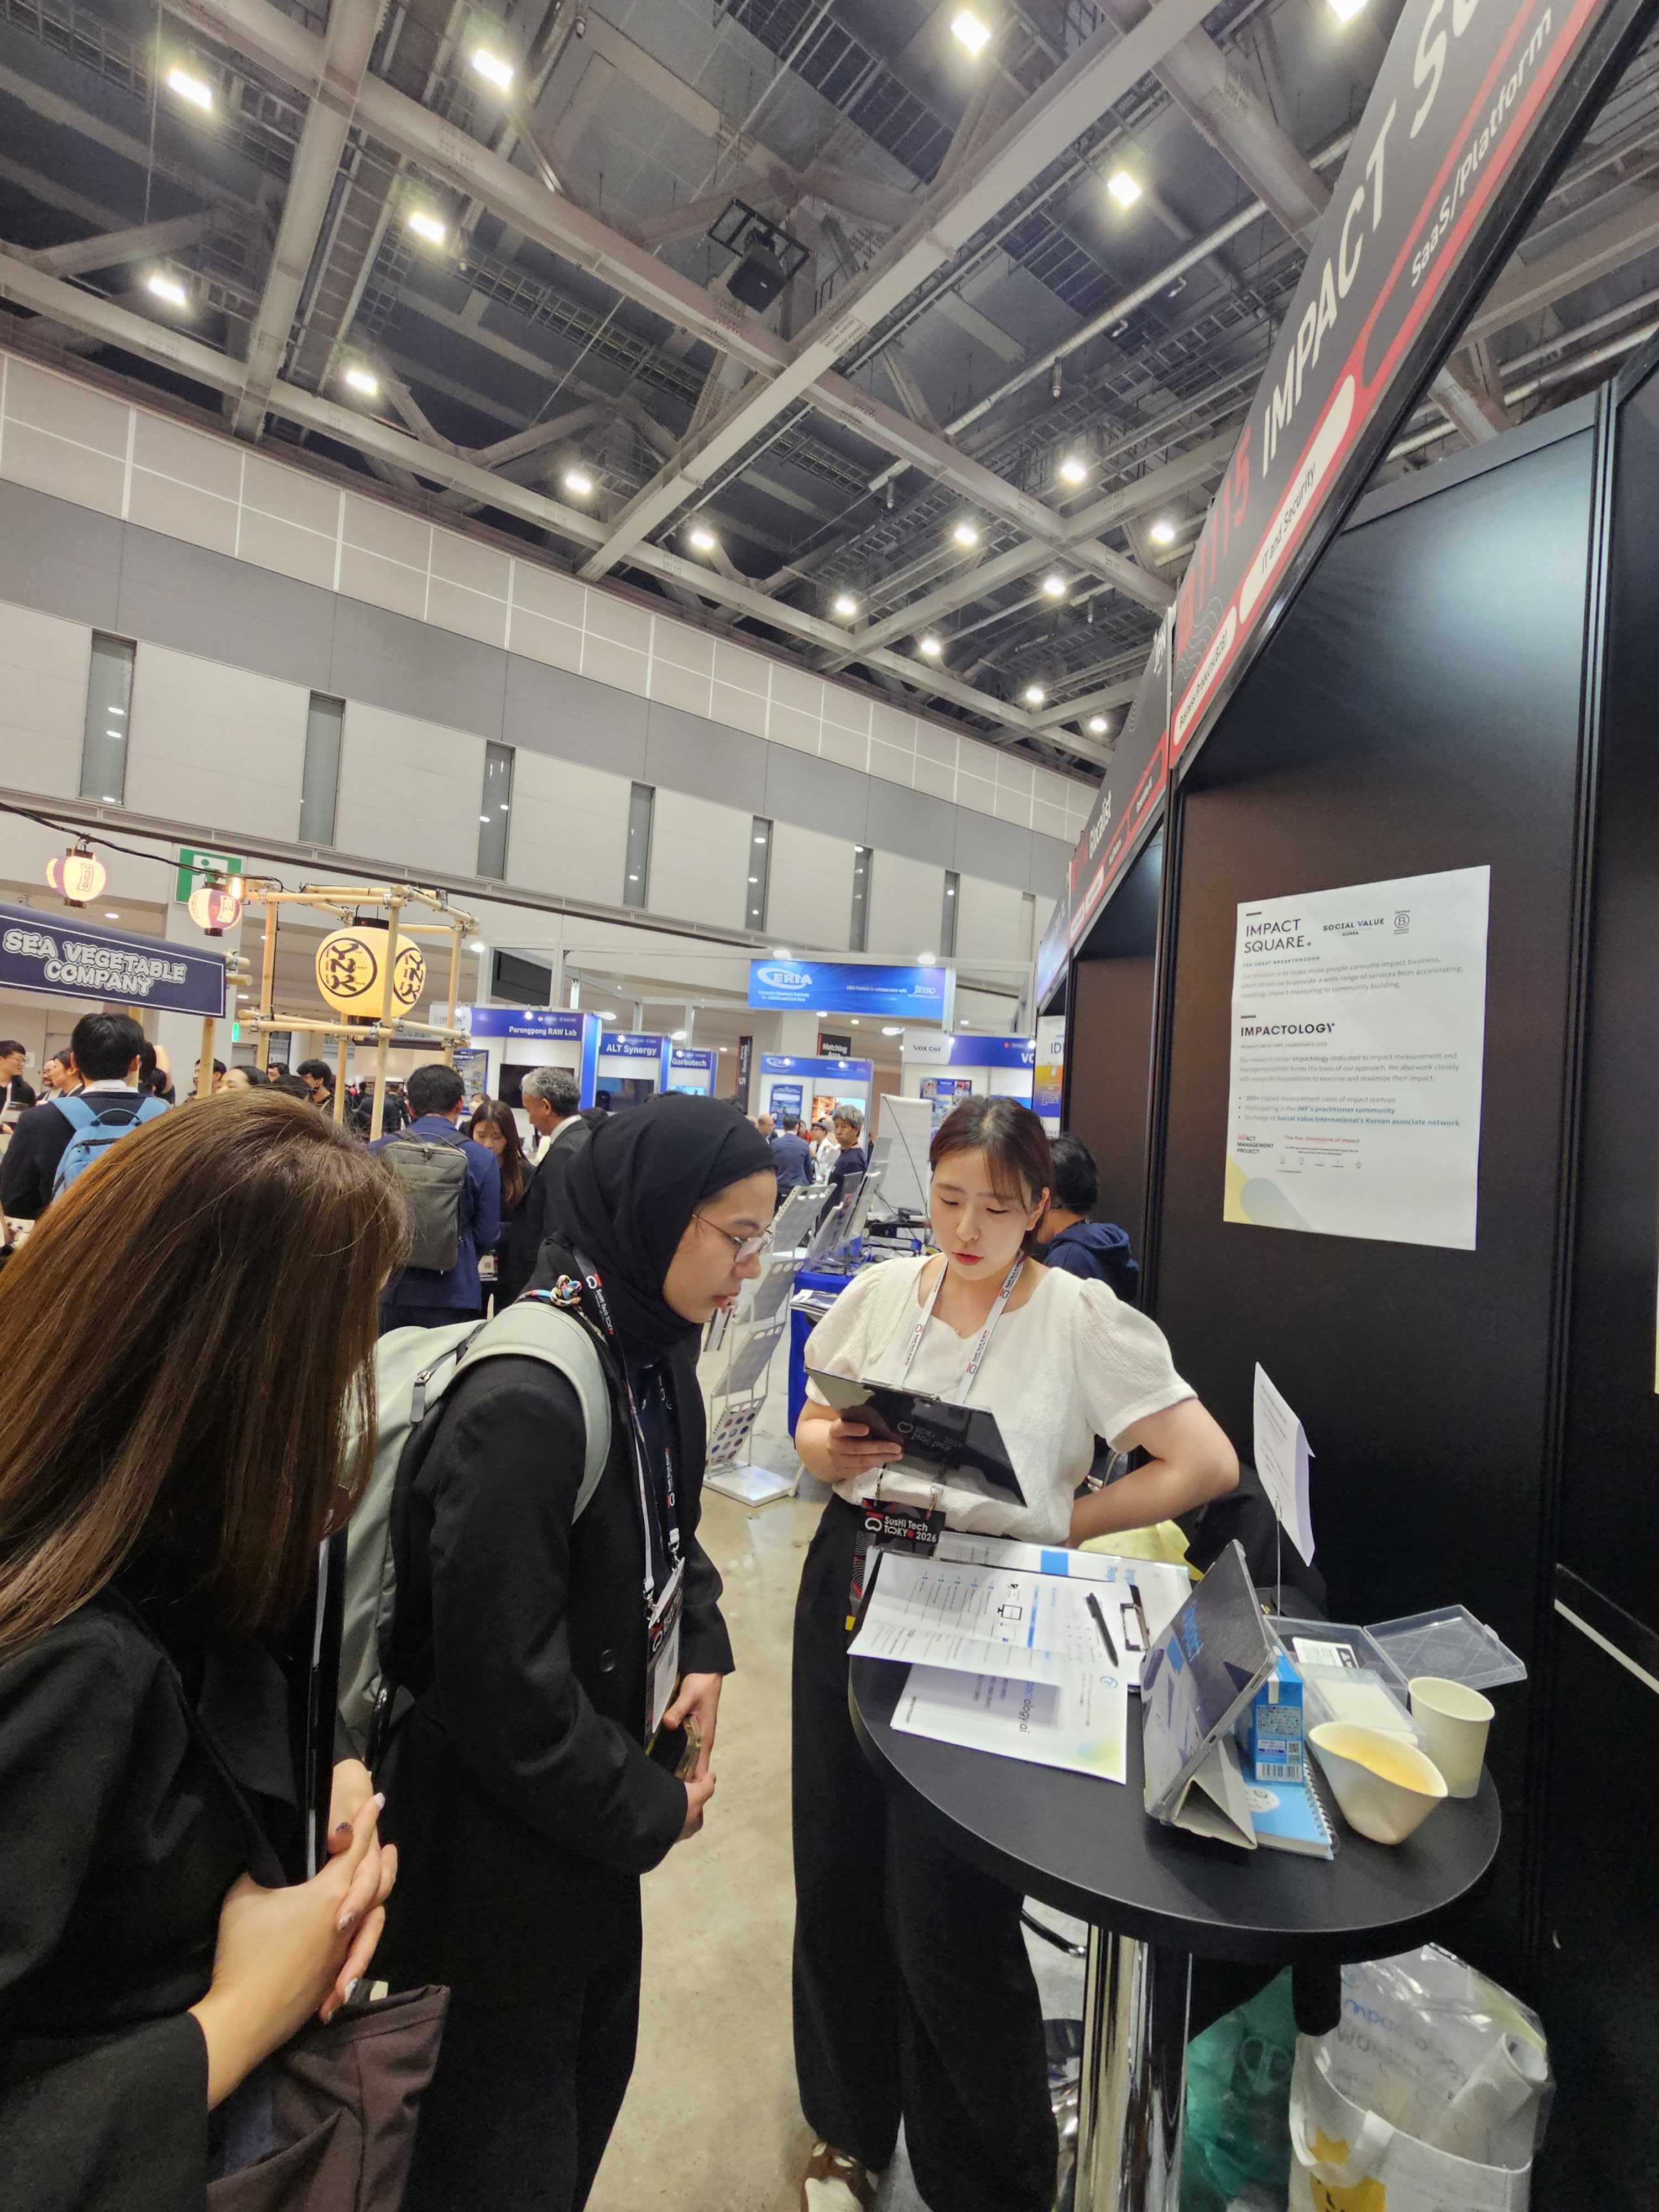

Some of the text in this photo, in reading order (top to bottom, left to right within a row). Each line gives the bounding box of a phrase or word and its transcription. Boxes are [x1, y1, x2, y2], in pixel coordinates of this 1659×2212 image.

[1411, 8, 1552, 288] SaaS/Platform
[1263, 0, 1478, 478] IMPACT S
[1261, 461, 1316, 575] IT and Security
[1246, 919, 1301, 937] IMPACT
[1323, 918, 1384, 931] SOCIAL VALUE
[3, 929, 186, 984] SEA VEGETABLE
[1383, 959, 1406, 968] impact
[45, 959, 154, 996] COMPANY
[509, 1026, 547, 1036] Parongpong
[606, 1044, 657, 1056] ALT Synergy
[822, 1042, 848, 1054] Matching
[739, 1077, 745, 1085] 5
[884, 1516, 928, 1532] SusHi Tech
[916, 1531, 937, 1542] 2026
